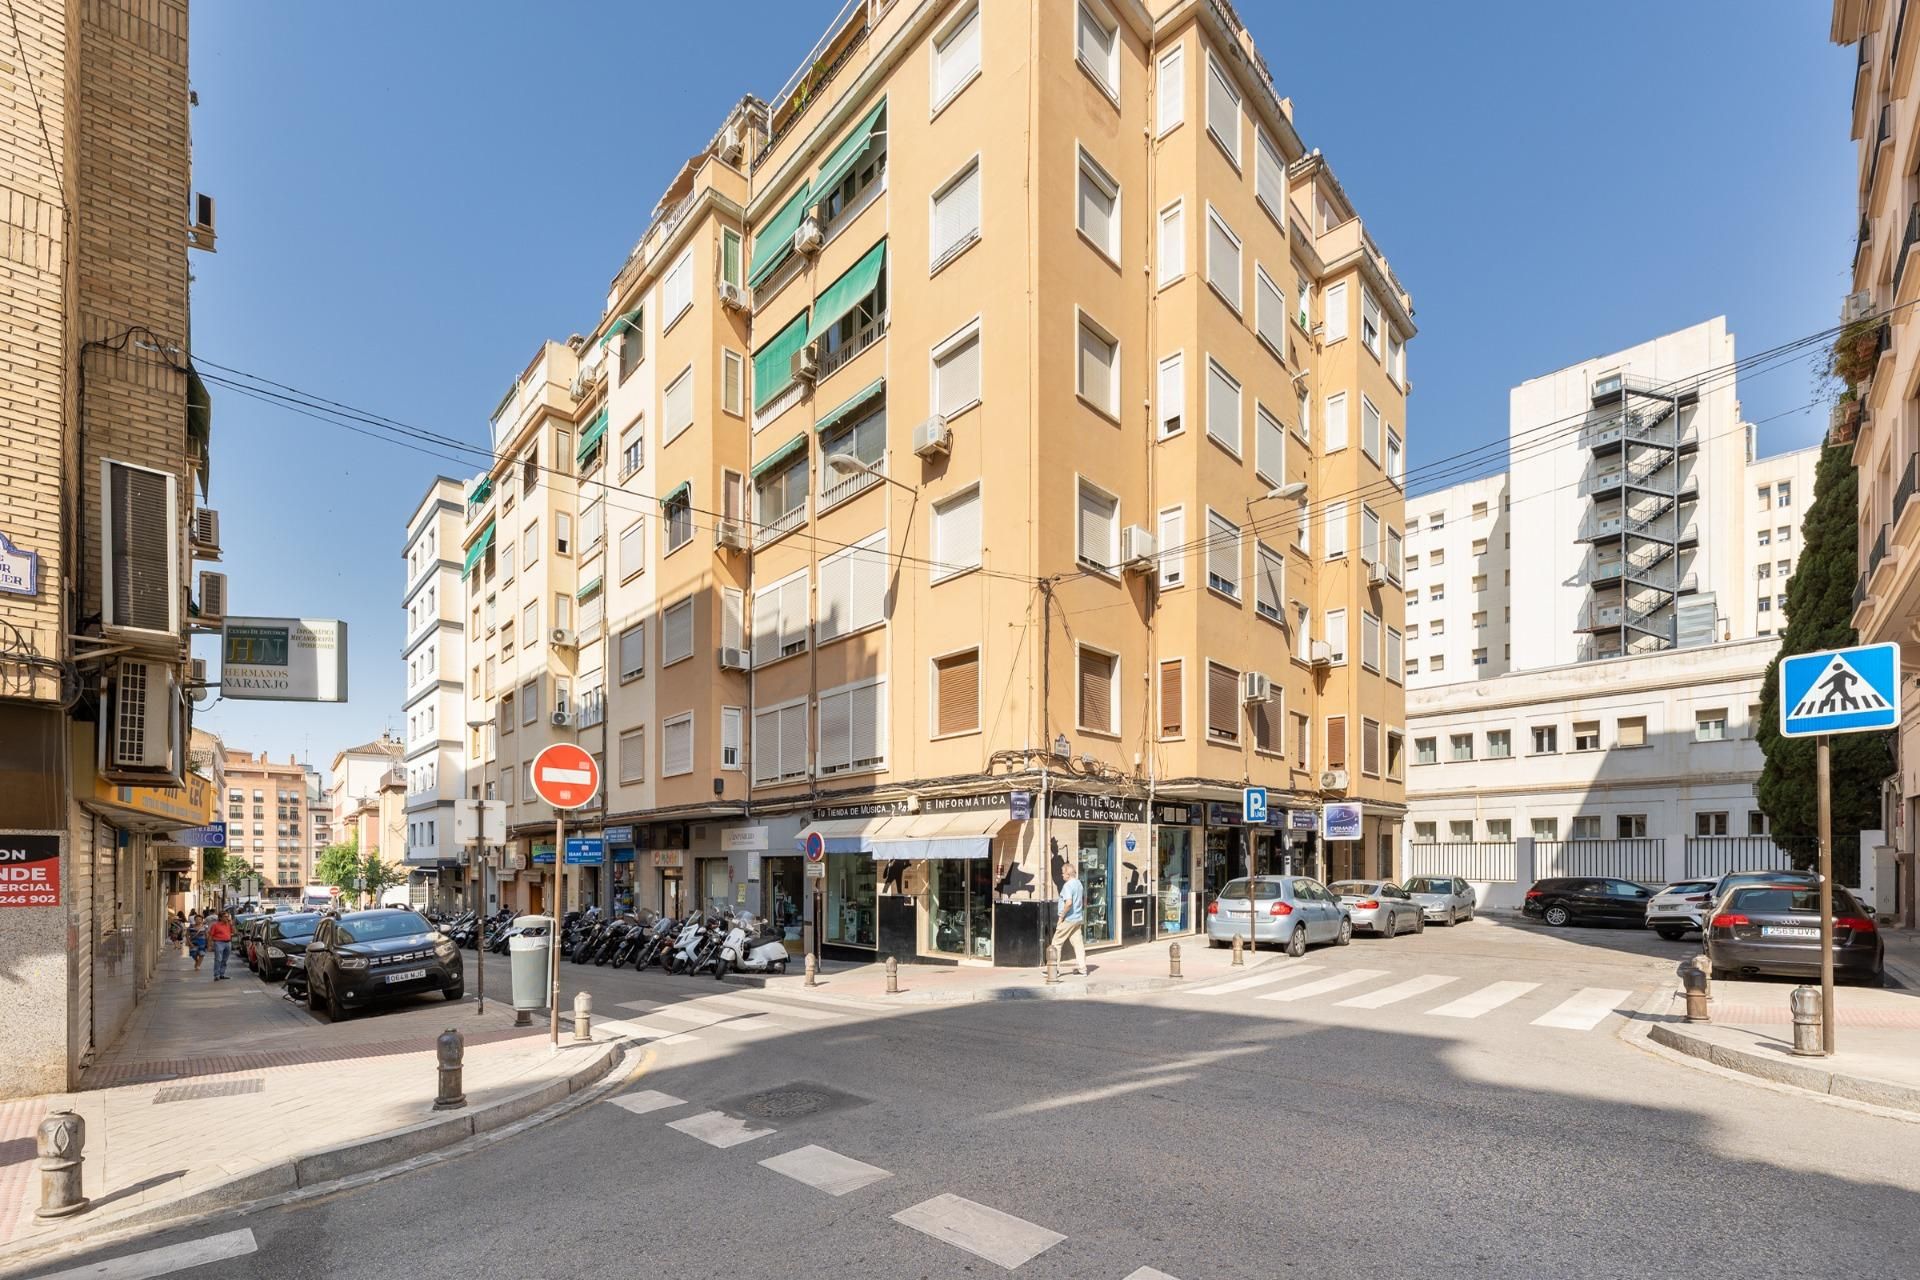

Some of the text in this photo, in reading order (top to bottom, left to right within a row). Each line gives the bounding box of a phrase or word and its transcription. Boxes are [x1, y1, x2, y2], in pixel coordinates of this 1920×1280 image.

[224, 667, 289, 678] HERMANOS
[224, 677, 289, 690] NARANJO
[817, 808, 826, 817] TU
[827, 807, 849, 817] TIENDA
[850, 807, 859, 816] DE
[926, 801, 932, 810] E
[1250, 792, 1262, 818] P
[1051, 804, 1139, 822] MÚSICA E INFORMÁTICA
[30, 895, 56, 903] 902
[1770, 928, 1795, 936] 2569
